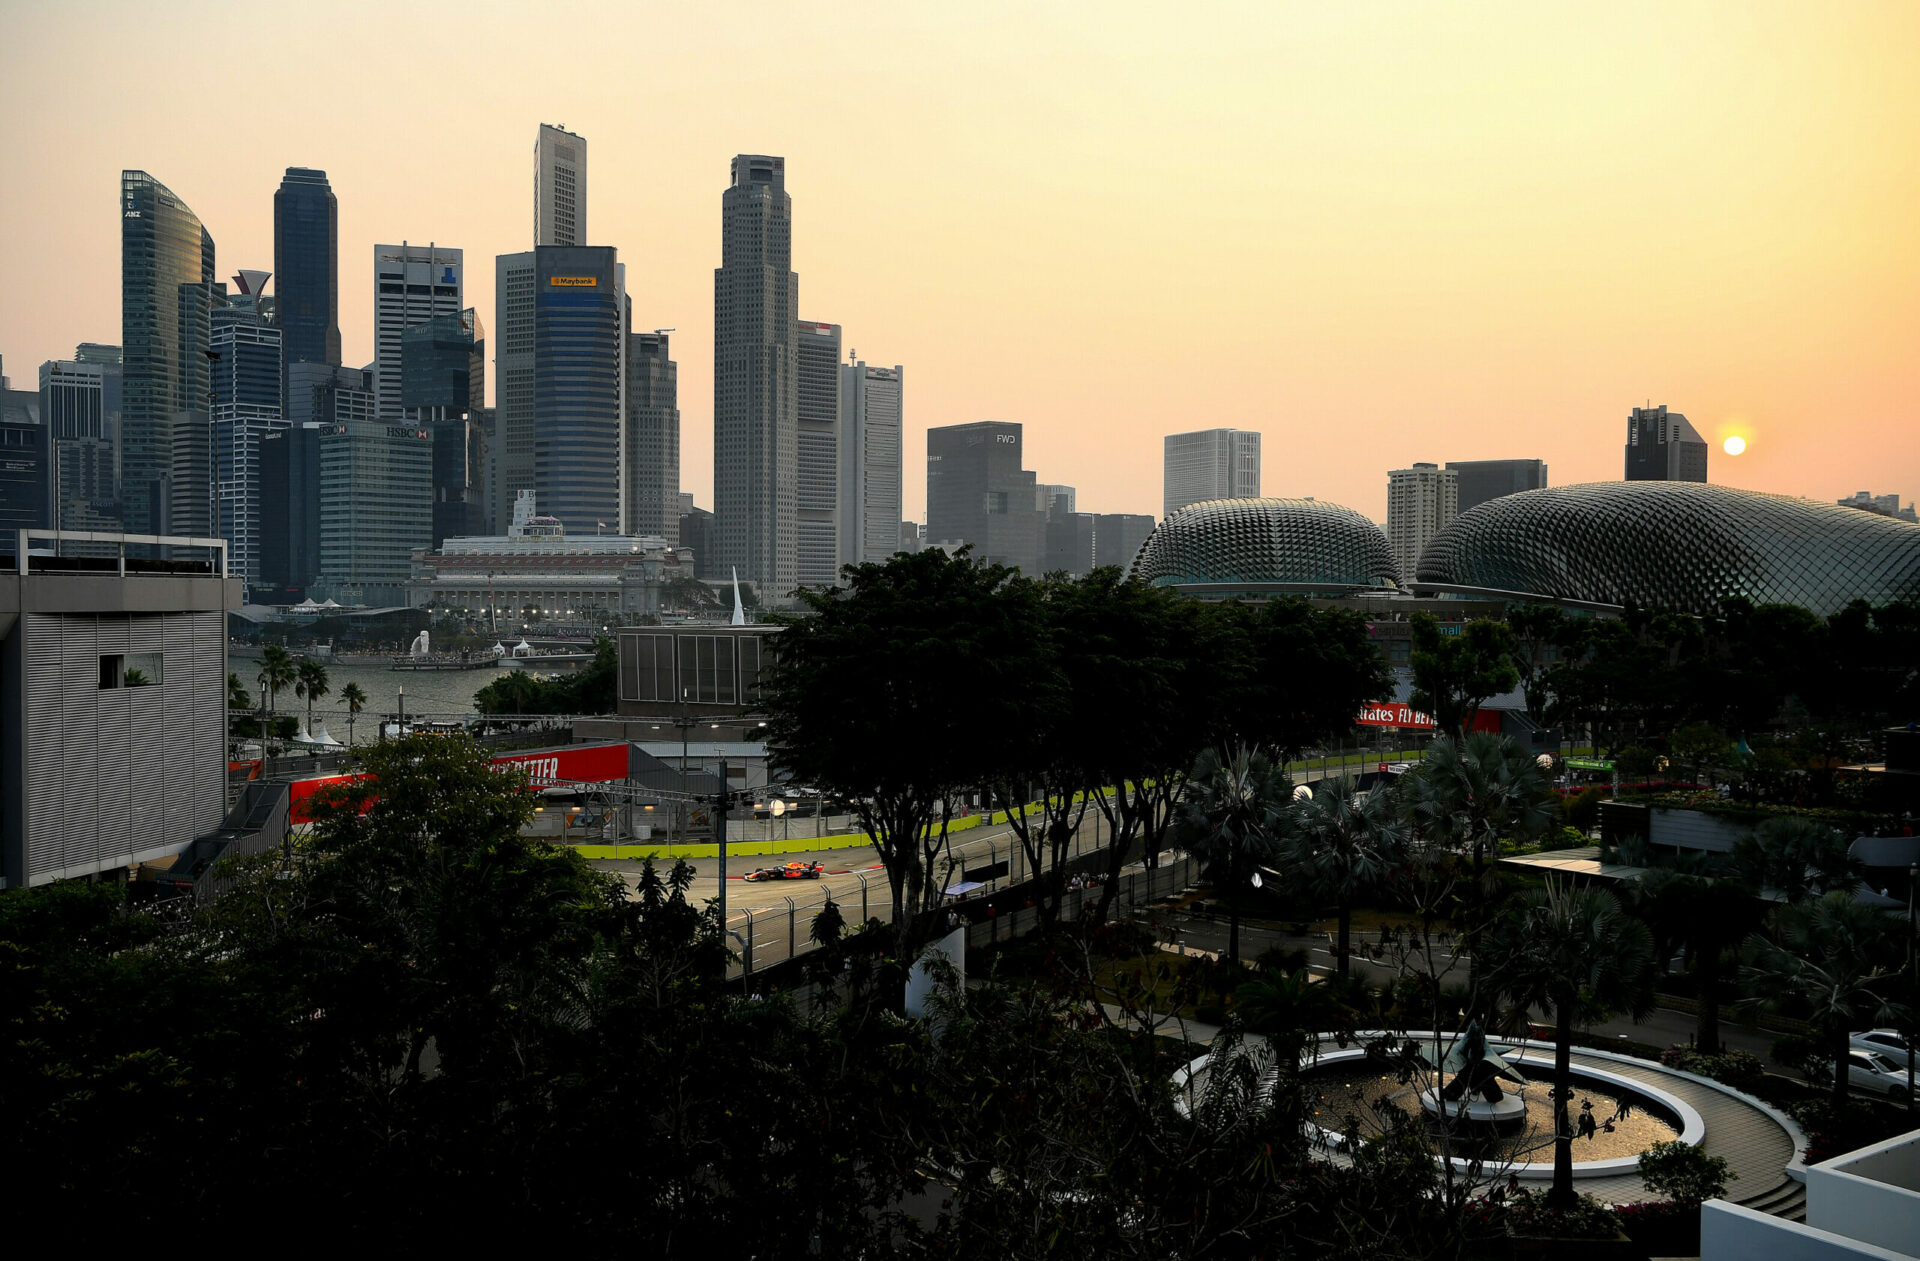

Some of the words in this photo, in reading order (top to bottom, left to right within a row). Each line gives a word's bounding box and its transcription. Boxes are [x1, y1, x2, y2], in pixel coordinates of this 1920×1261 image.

[319, 424, 337, 437] HSBC
[386, 426, 415, 438] HSBC
[996, 434, 1016, 444] FWD
[1439, 624, 1462, 635] mall
[1398, 708, 1413, 723] FLY
